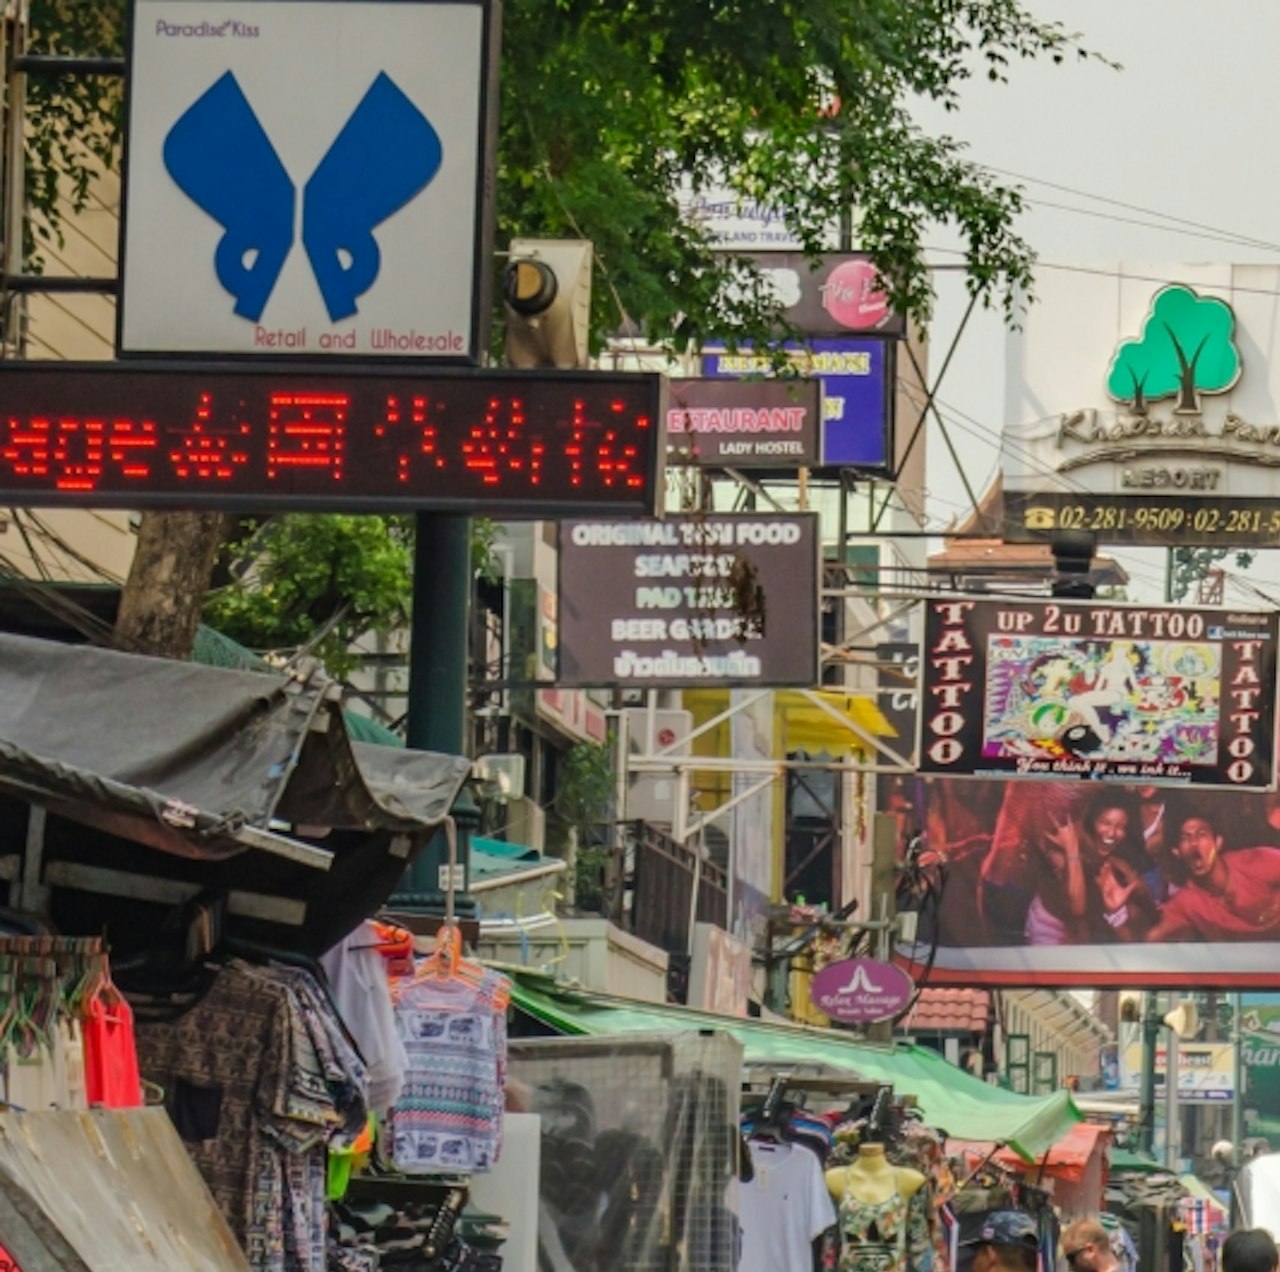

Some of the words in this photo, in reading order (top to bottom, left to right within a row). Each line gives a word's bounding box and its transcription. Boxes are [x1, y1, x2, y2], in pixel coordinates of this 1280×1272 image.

[155, 20, 225, 38] Paradise
[232, 20, 260, 38] Kiss
[254, 326, 306, 349] Retail
[319, 328, 356, 349] and
[371, 328, 464, 351] Wholesale
[719, 442, 753, 455] LADY
[755, 442, 805, 455] HOSTEL
[1121, 466, 1222, 491] RESORT
[571, 523, 679, 547] ORIGINAL
[735, 522, 801, 546] FOOD
[635, 586, 683, 609] PAD
[610, 618, 668, 641] BEER
[997, 612, 1034, 633] UP
[1090, 610, 1204, 639] TATTOO
[928, 600, 977, 766] TATTOO
[1227, 639, 1266, 784] TATTOO
